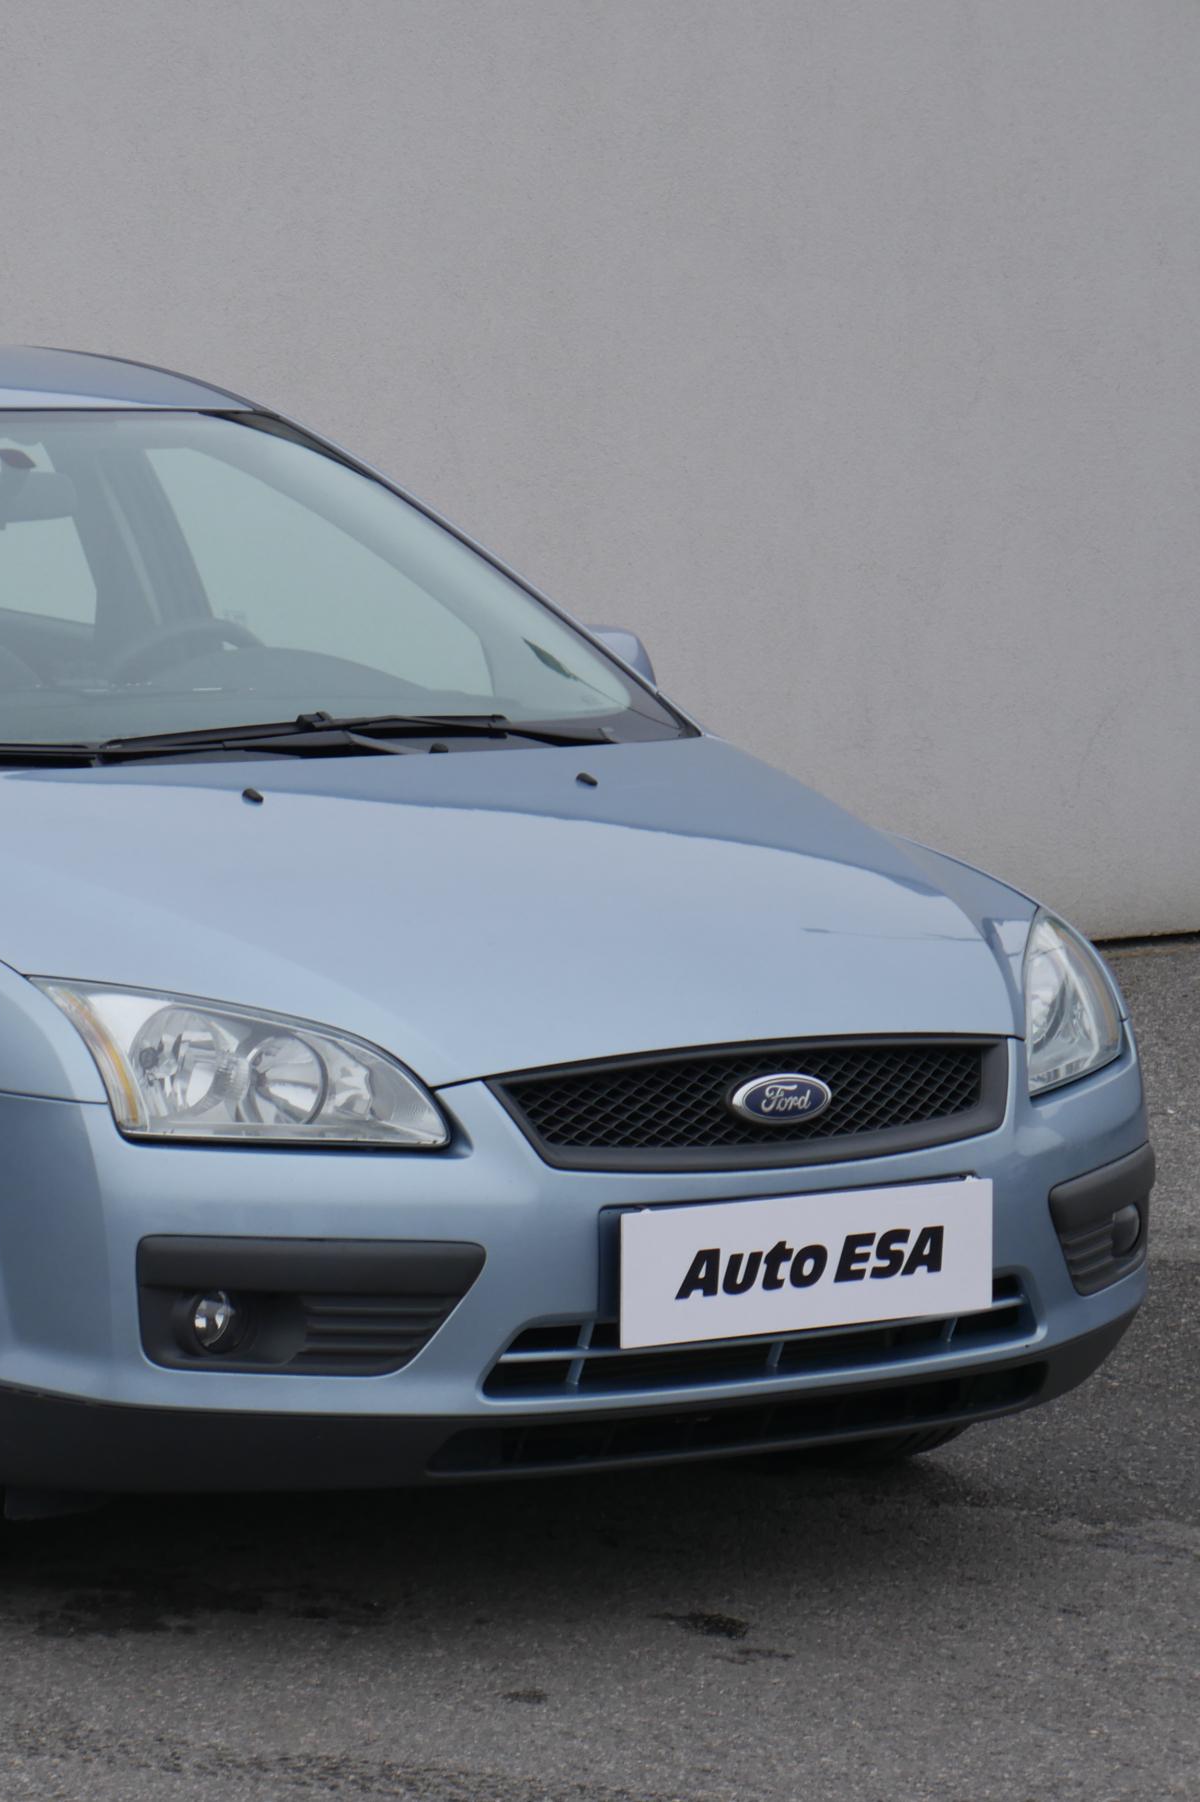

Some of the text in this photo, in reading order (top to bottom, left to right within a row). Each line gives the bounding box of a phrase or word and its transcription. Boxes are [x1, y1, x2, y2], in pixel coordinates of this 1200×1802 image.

[761, 1084, 811, 1113] Ford
[674, 1225, 944, 1300] Auto ESA
